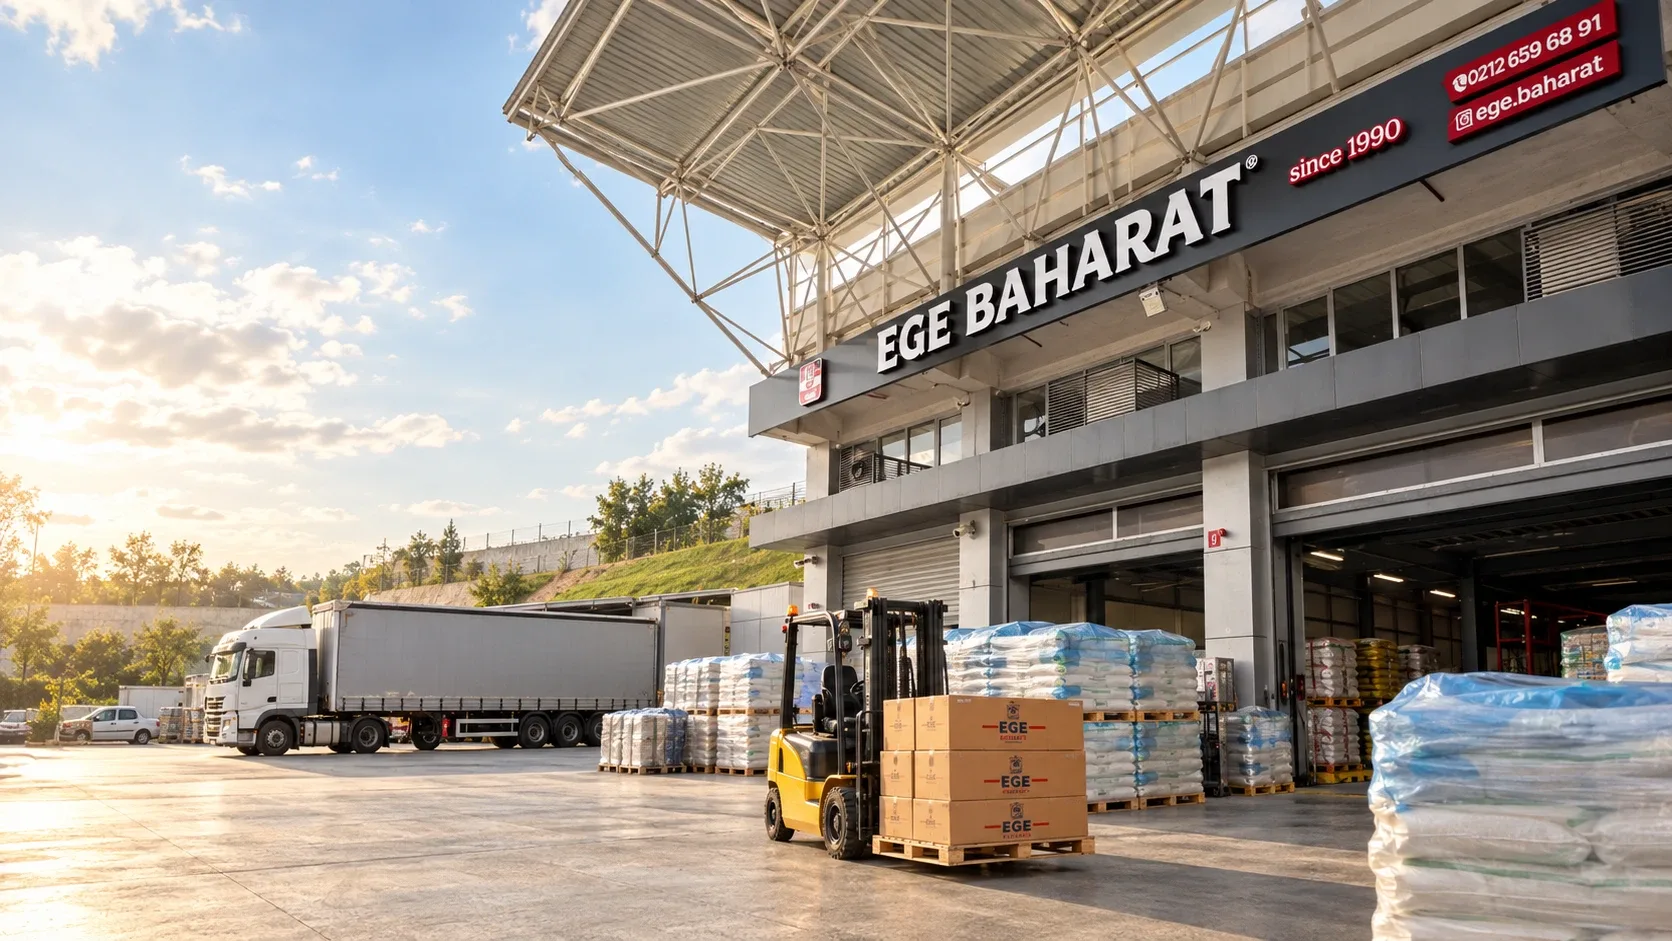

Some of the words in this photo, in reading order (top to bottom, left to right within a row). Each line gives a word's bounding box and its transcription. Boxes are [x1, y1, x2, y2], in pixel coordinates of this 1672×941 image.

[1467, 57, 1506, 86] 0212
[1507, 41, 1542, 68] 659
[1546, 26, 1573, 51] 68
[1577, 13, 1602, 37] 91
[1475, 56, 1604, 120] ege.baharat
[1290, 148, 1342, 182] since
[1347, 118, 1401, 158] 1990
[877, 299, 951, 373] EGE
[999, 721, 1028, 734] EGE
[1001, 775, 1031, 788] EGE
[1002, 820, 1032, 833] EGE
